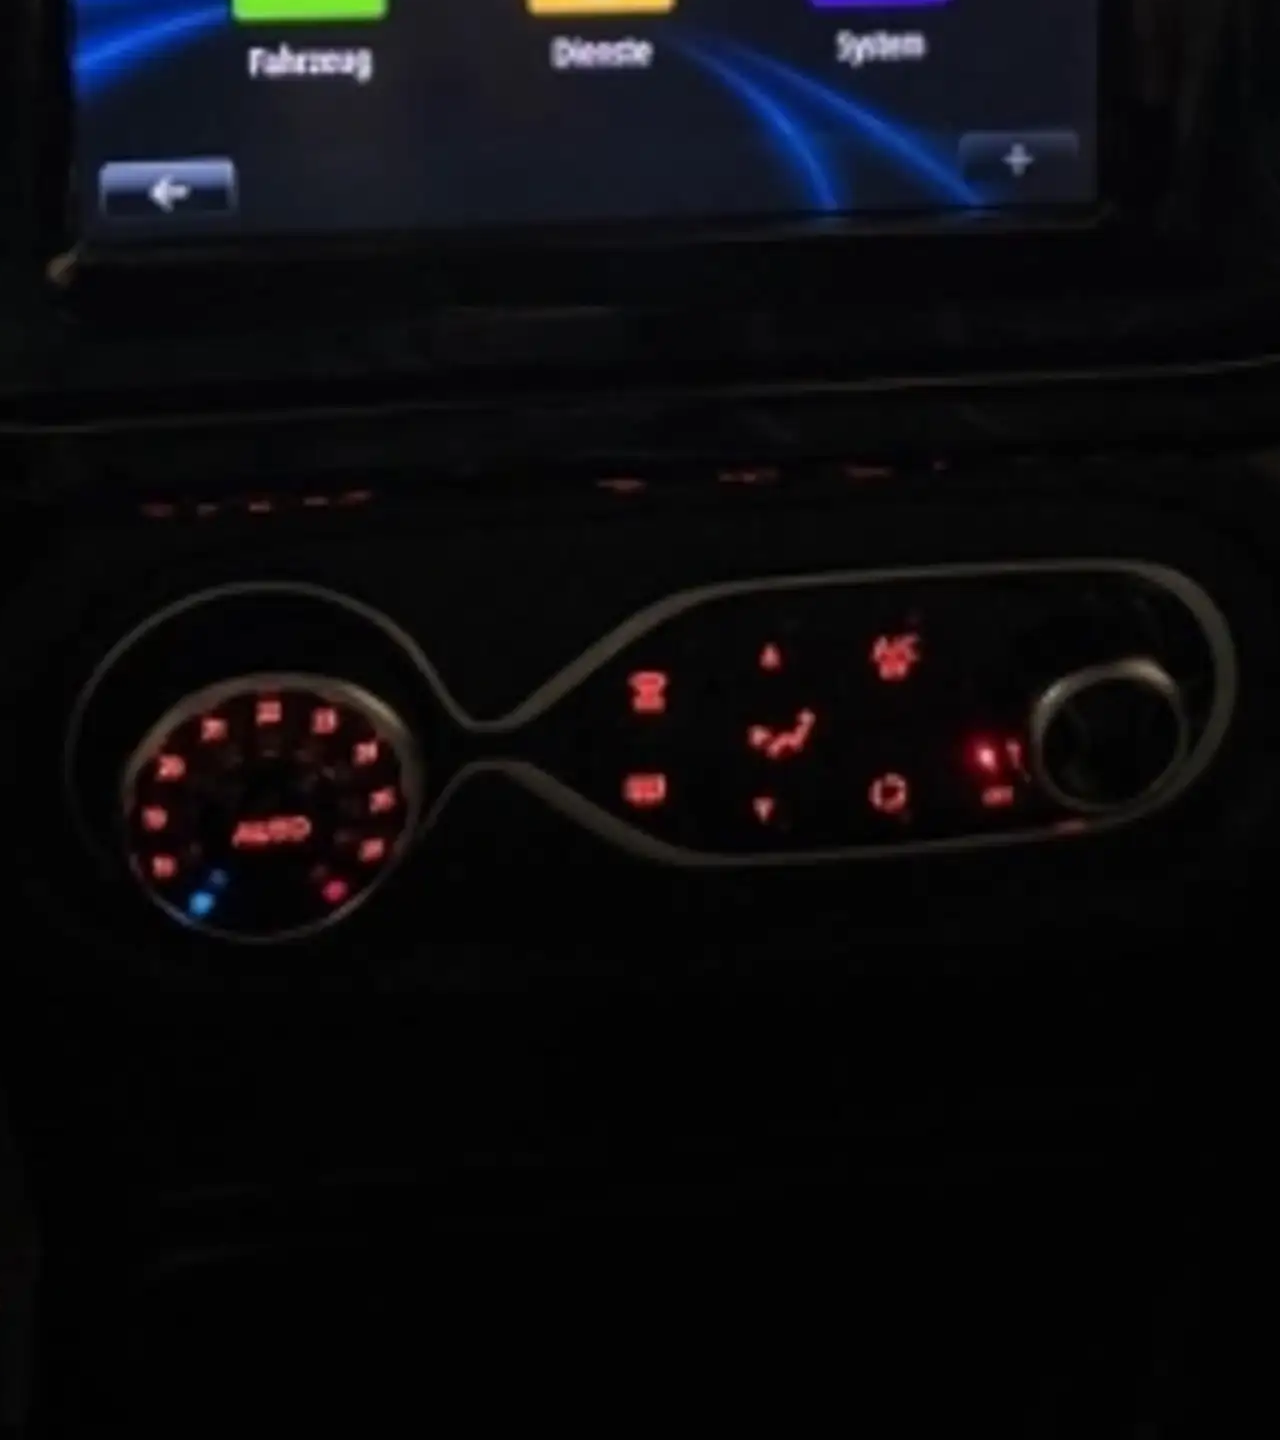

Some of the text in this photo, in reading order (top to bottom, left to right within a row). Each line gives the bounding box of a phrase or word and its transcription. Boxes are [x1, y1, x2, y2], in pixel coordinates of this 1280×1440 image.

[248, 41, 374, 84] Fahrzeug
[550, 35, 655, 70] Dienste
[835, 29, 926, 67] System
